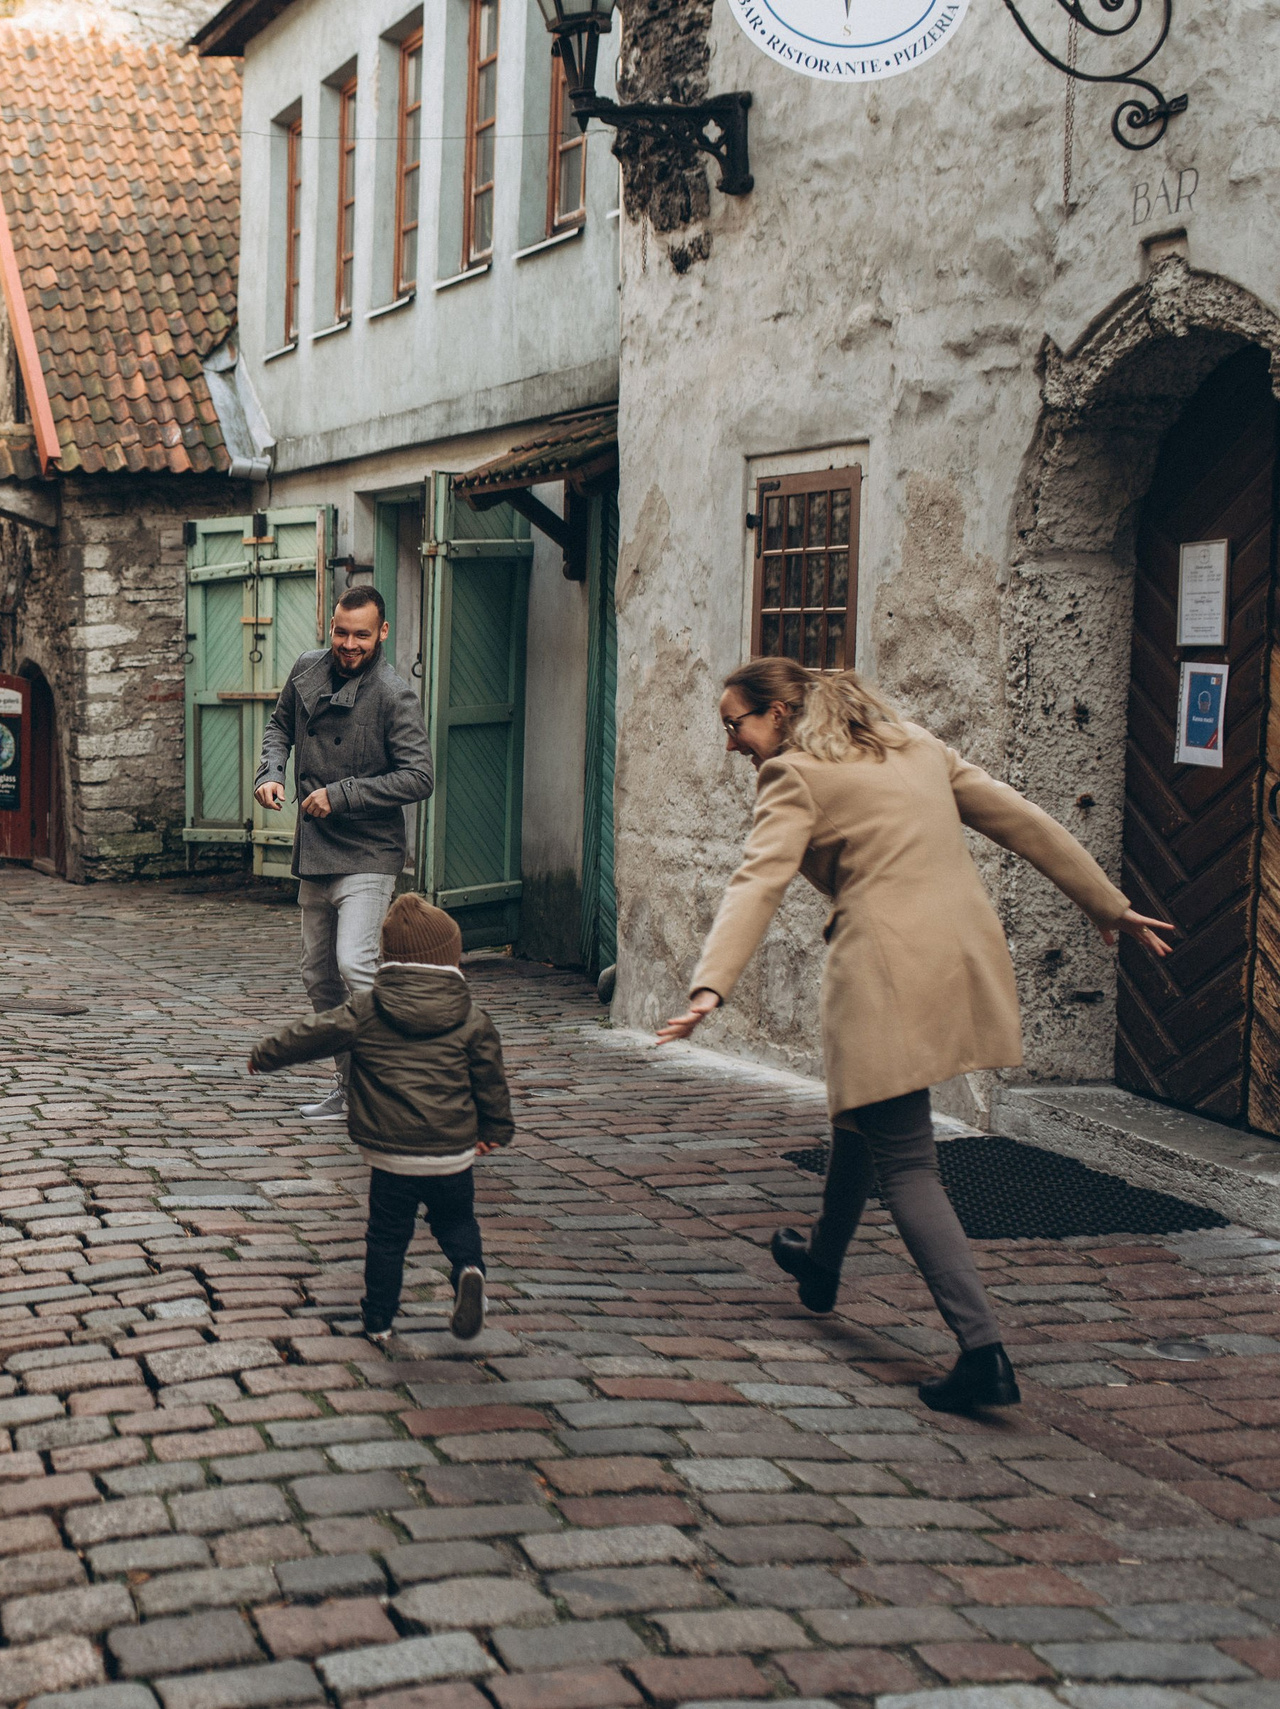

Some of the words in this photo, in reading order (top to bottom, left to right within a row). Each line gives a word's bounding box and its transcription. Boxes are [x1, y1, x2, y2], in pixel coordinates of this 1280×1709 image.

[766, 35, 882, 75] RISTORANTE
[894, 4, 960, 66] PIZZERIA
[843, 24, 852, 37] S
[1130, 167, 1199, 227] BAR
[0, 773, 16, 783] glass
